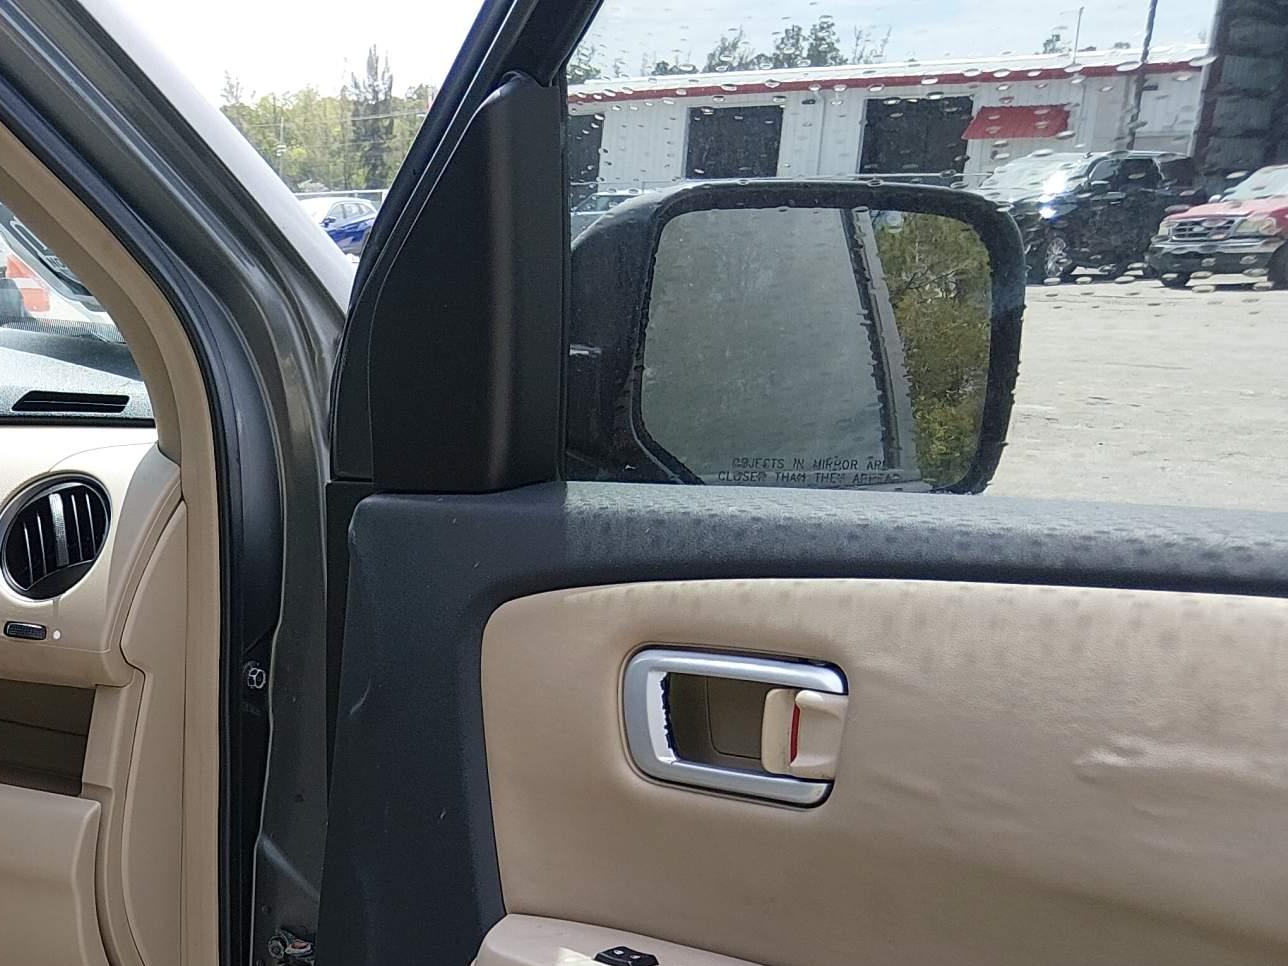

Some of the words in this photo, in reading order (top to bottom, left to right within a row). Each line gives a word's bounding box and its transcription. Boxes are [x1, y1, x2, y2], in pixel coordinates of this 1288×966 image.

[732, 457, 785, 469] OBJECTS
[793, 457, 805, 470] IN
[812, 456, 859, 471] MIRROR
